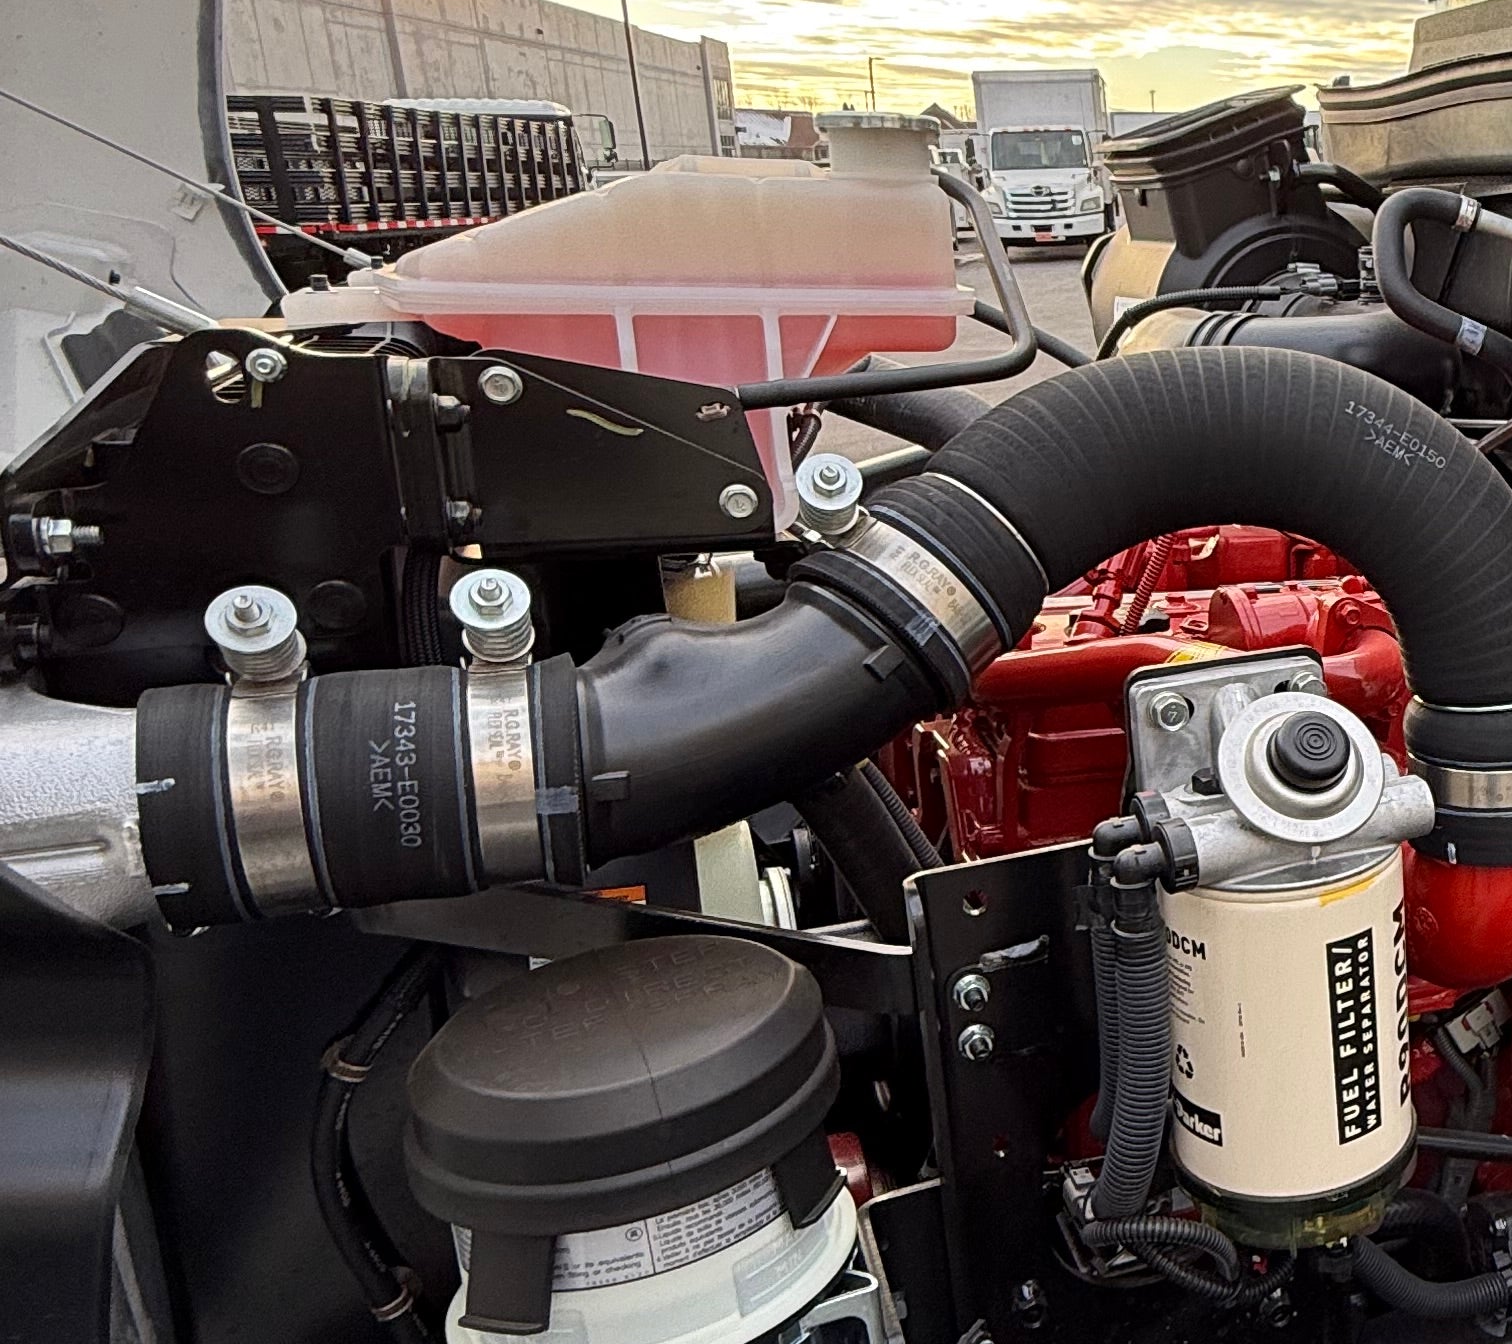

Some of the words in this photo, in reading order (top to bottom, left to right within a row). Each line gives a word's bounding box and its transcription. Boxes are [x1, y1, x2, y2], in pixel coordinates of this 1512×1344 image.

[1344, 400, 1447, 469] 17344-E0150
[393, 700, 422, 848] 17343-E0030
[1331, 946, 1358, 1059] FILTER/
[1357, 935, 1374, 1055] SEPARATOR
[1341, 1067, 1363, 1139] FUEL
[1363, 1061, 1377, 1130] WATER
